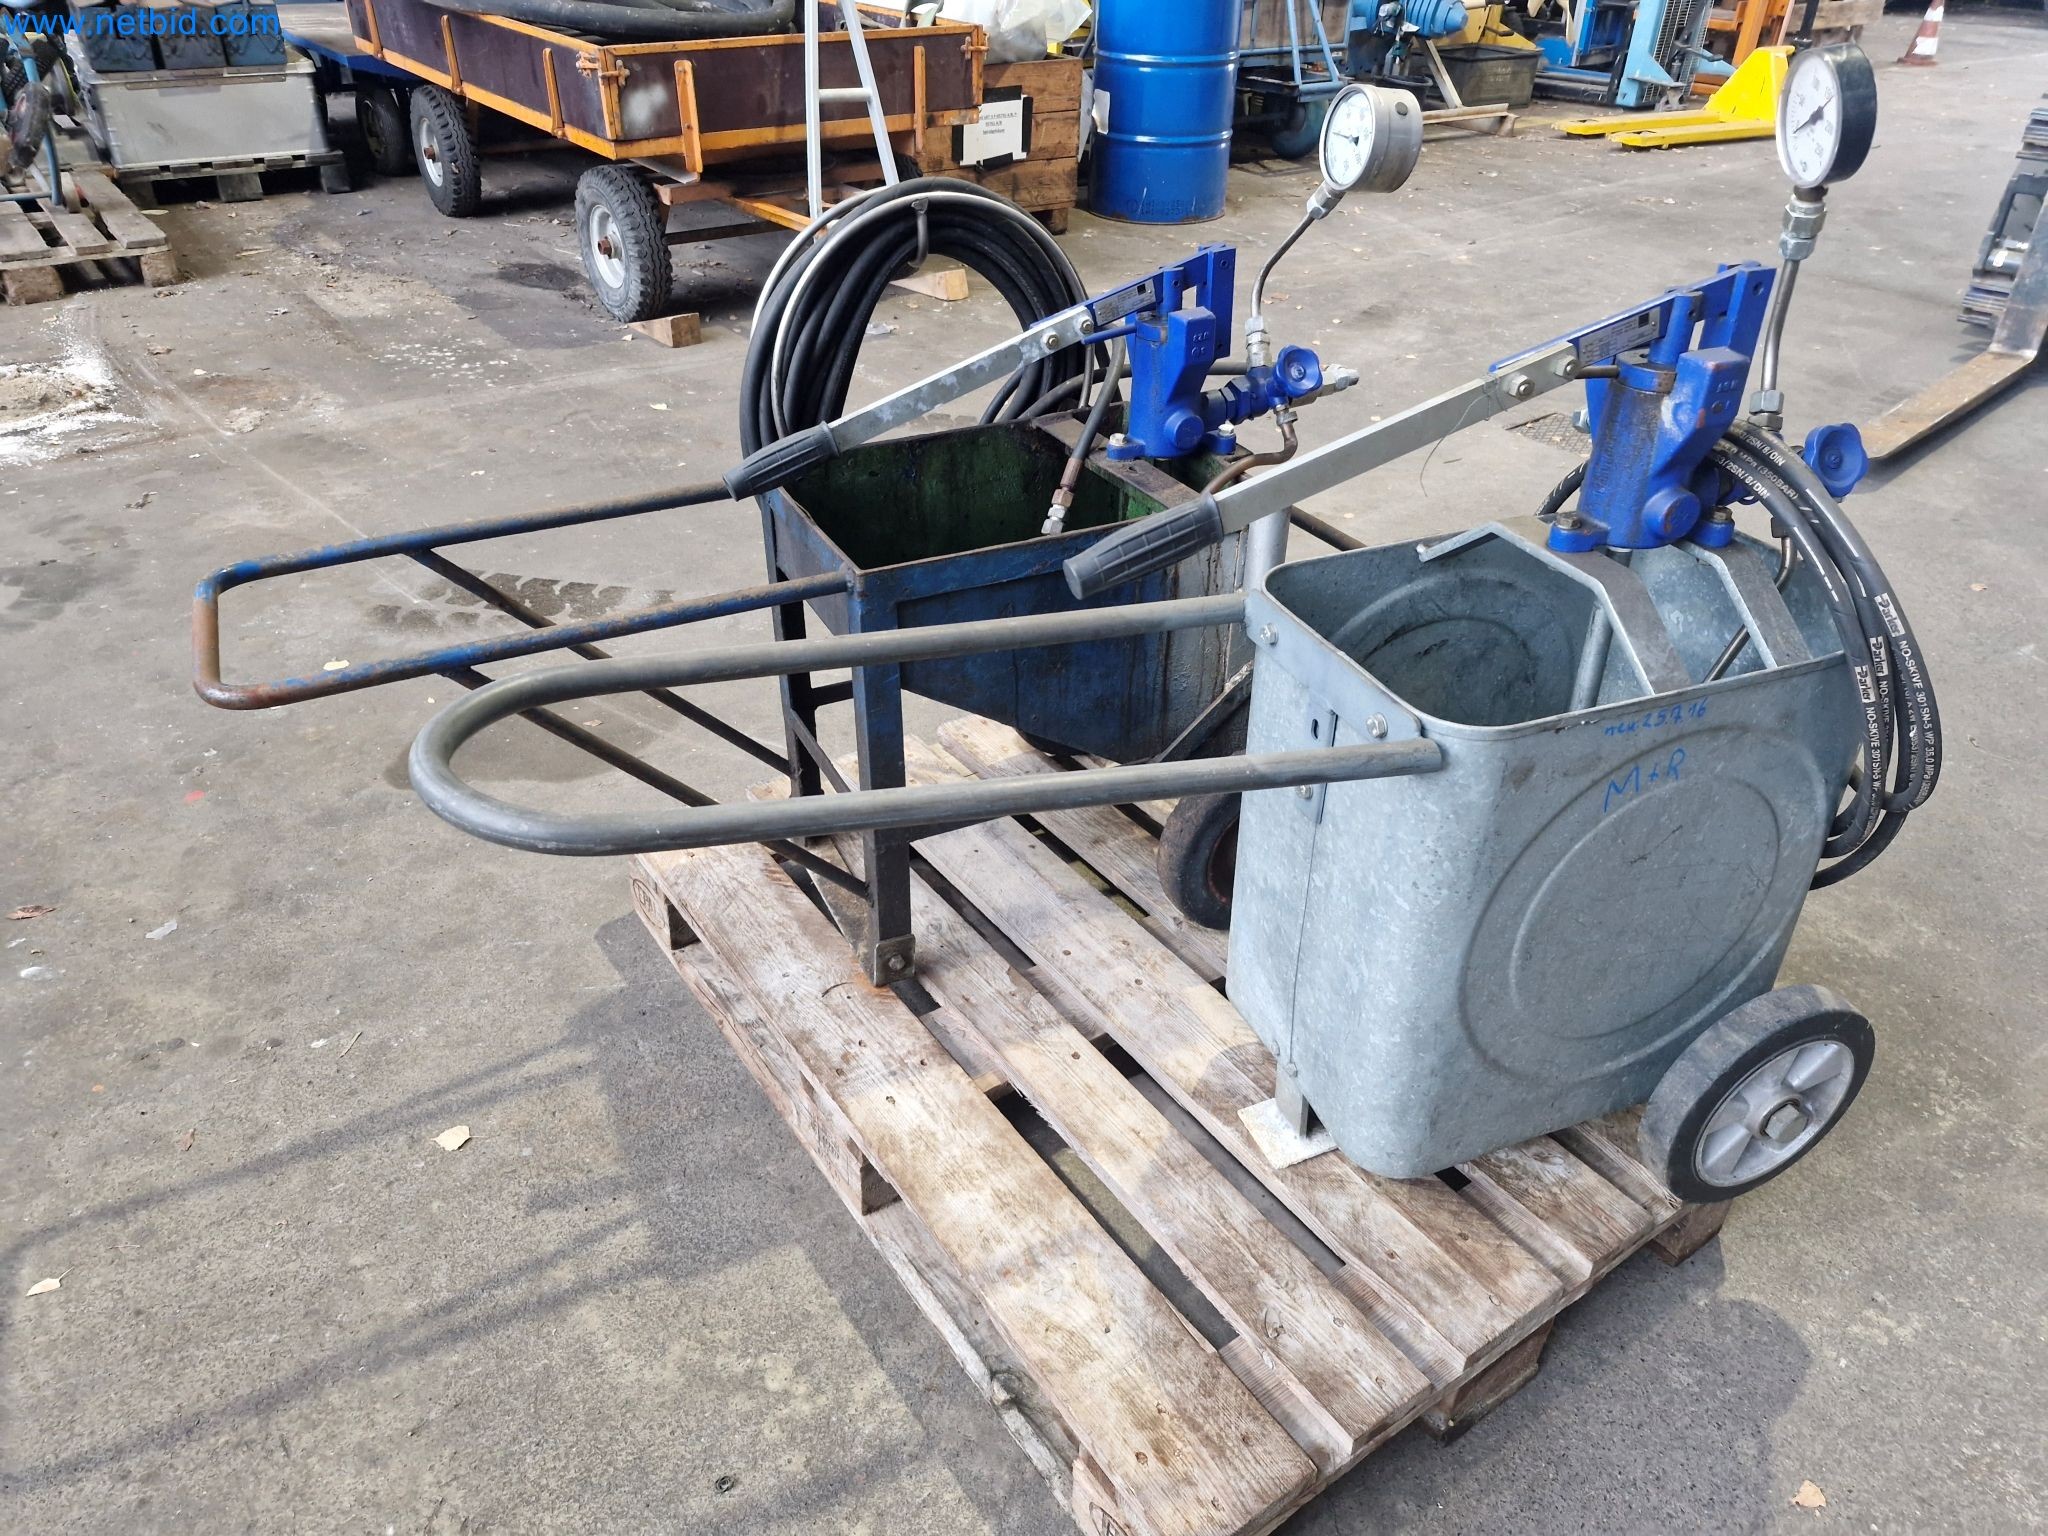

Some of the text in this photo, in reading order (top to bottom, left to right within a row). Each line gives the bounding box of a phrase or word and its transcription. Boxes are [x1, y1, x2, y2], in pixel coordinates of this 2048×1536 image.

[1871, 637, 1887, 675] Parker
[1876, 595, 1903, 636] Parker
[1900, 641, 1923, 688] NO-SKIVE
[1856, 666, 1874, 702] Parker
[1865, 707, 1880, 747] NO-SKIVE
